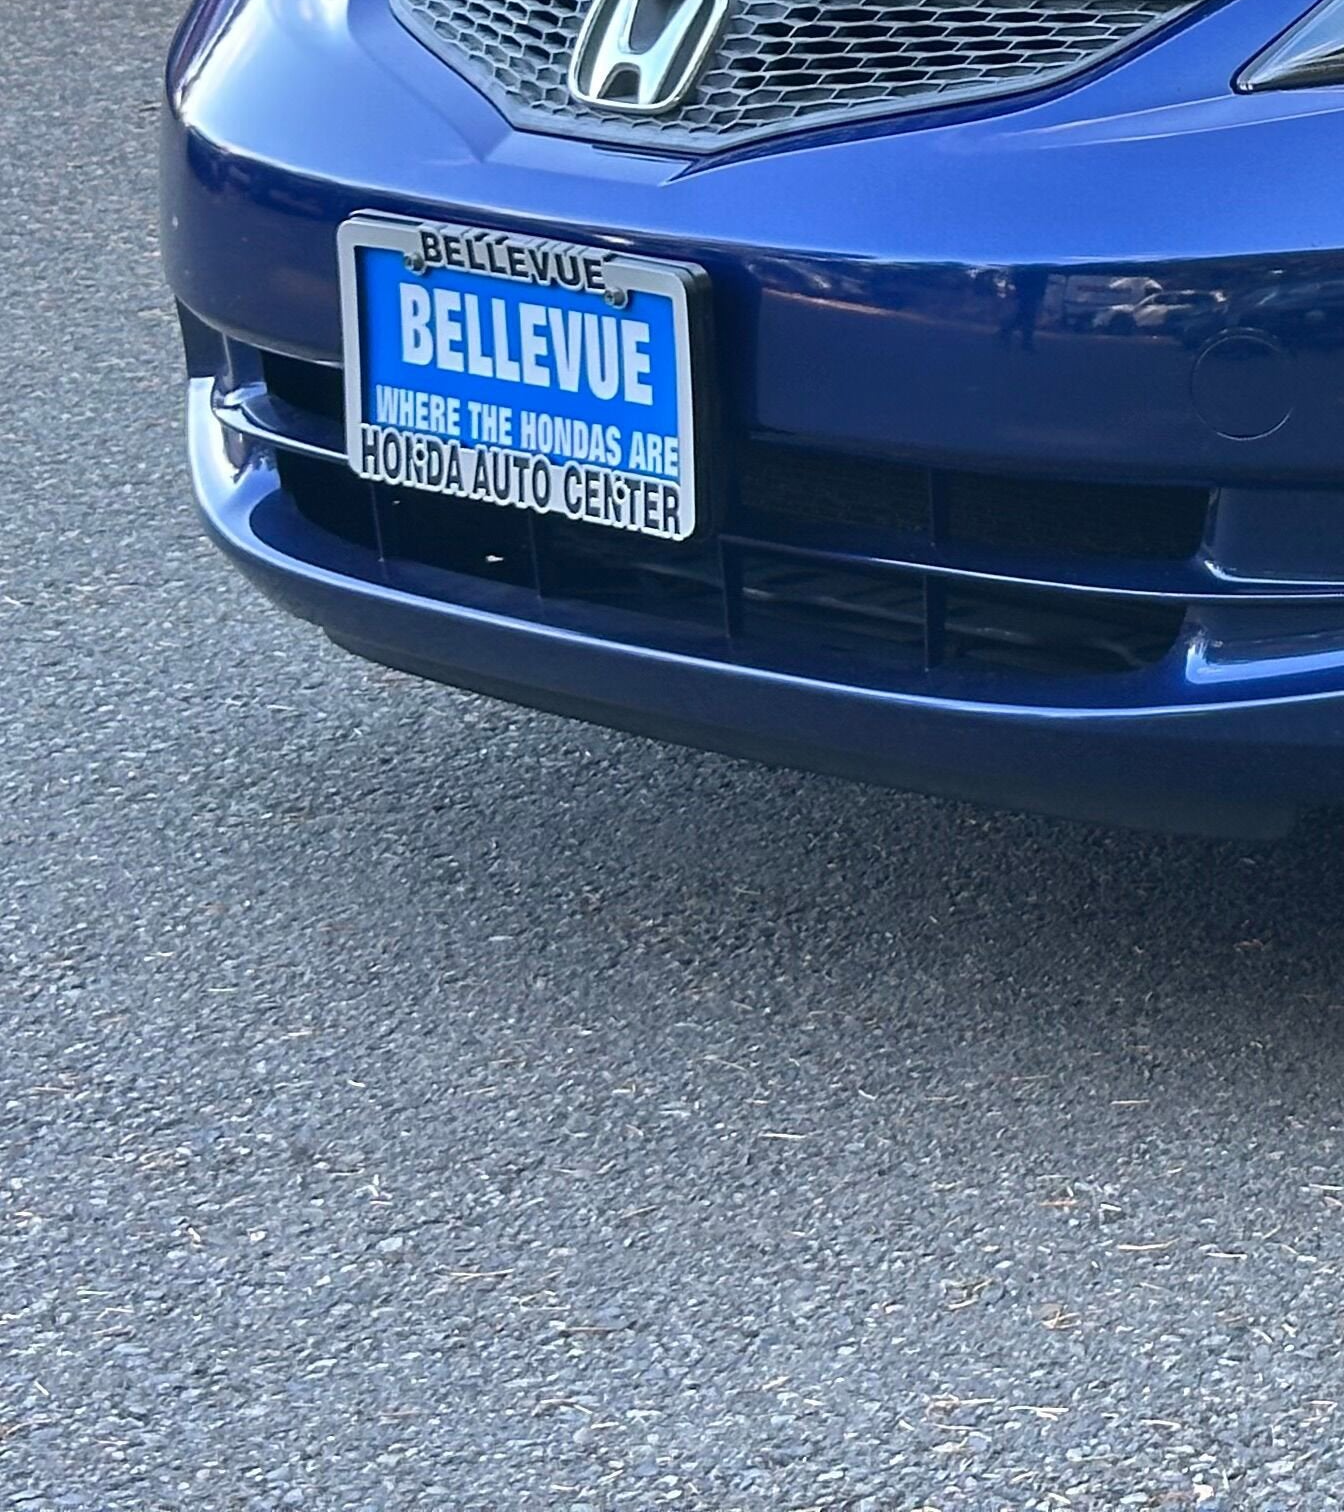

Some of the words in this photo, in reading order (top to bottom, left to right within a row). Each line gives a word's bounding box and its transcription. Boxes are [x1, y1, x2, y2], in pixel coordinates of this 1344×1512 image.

[421, 231, 606, 290] BELLEVUE
[398, 283, 653, 406] BELLEVUE
[361, 427, 464, 492] HONDA
[473, 448, 551, 508] AUTO
[564, 465, 681, 534] CENTER
[376, 385, 461, 436] WHERE
[468, 401, 512, 446] THE
[520, 410, 622, 467] HONDAS
[628, 431, 680, 477] ARE
